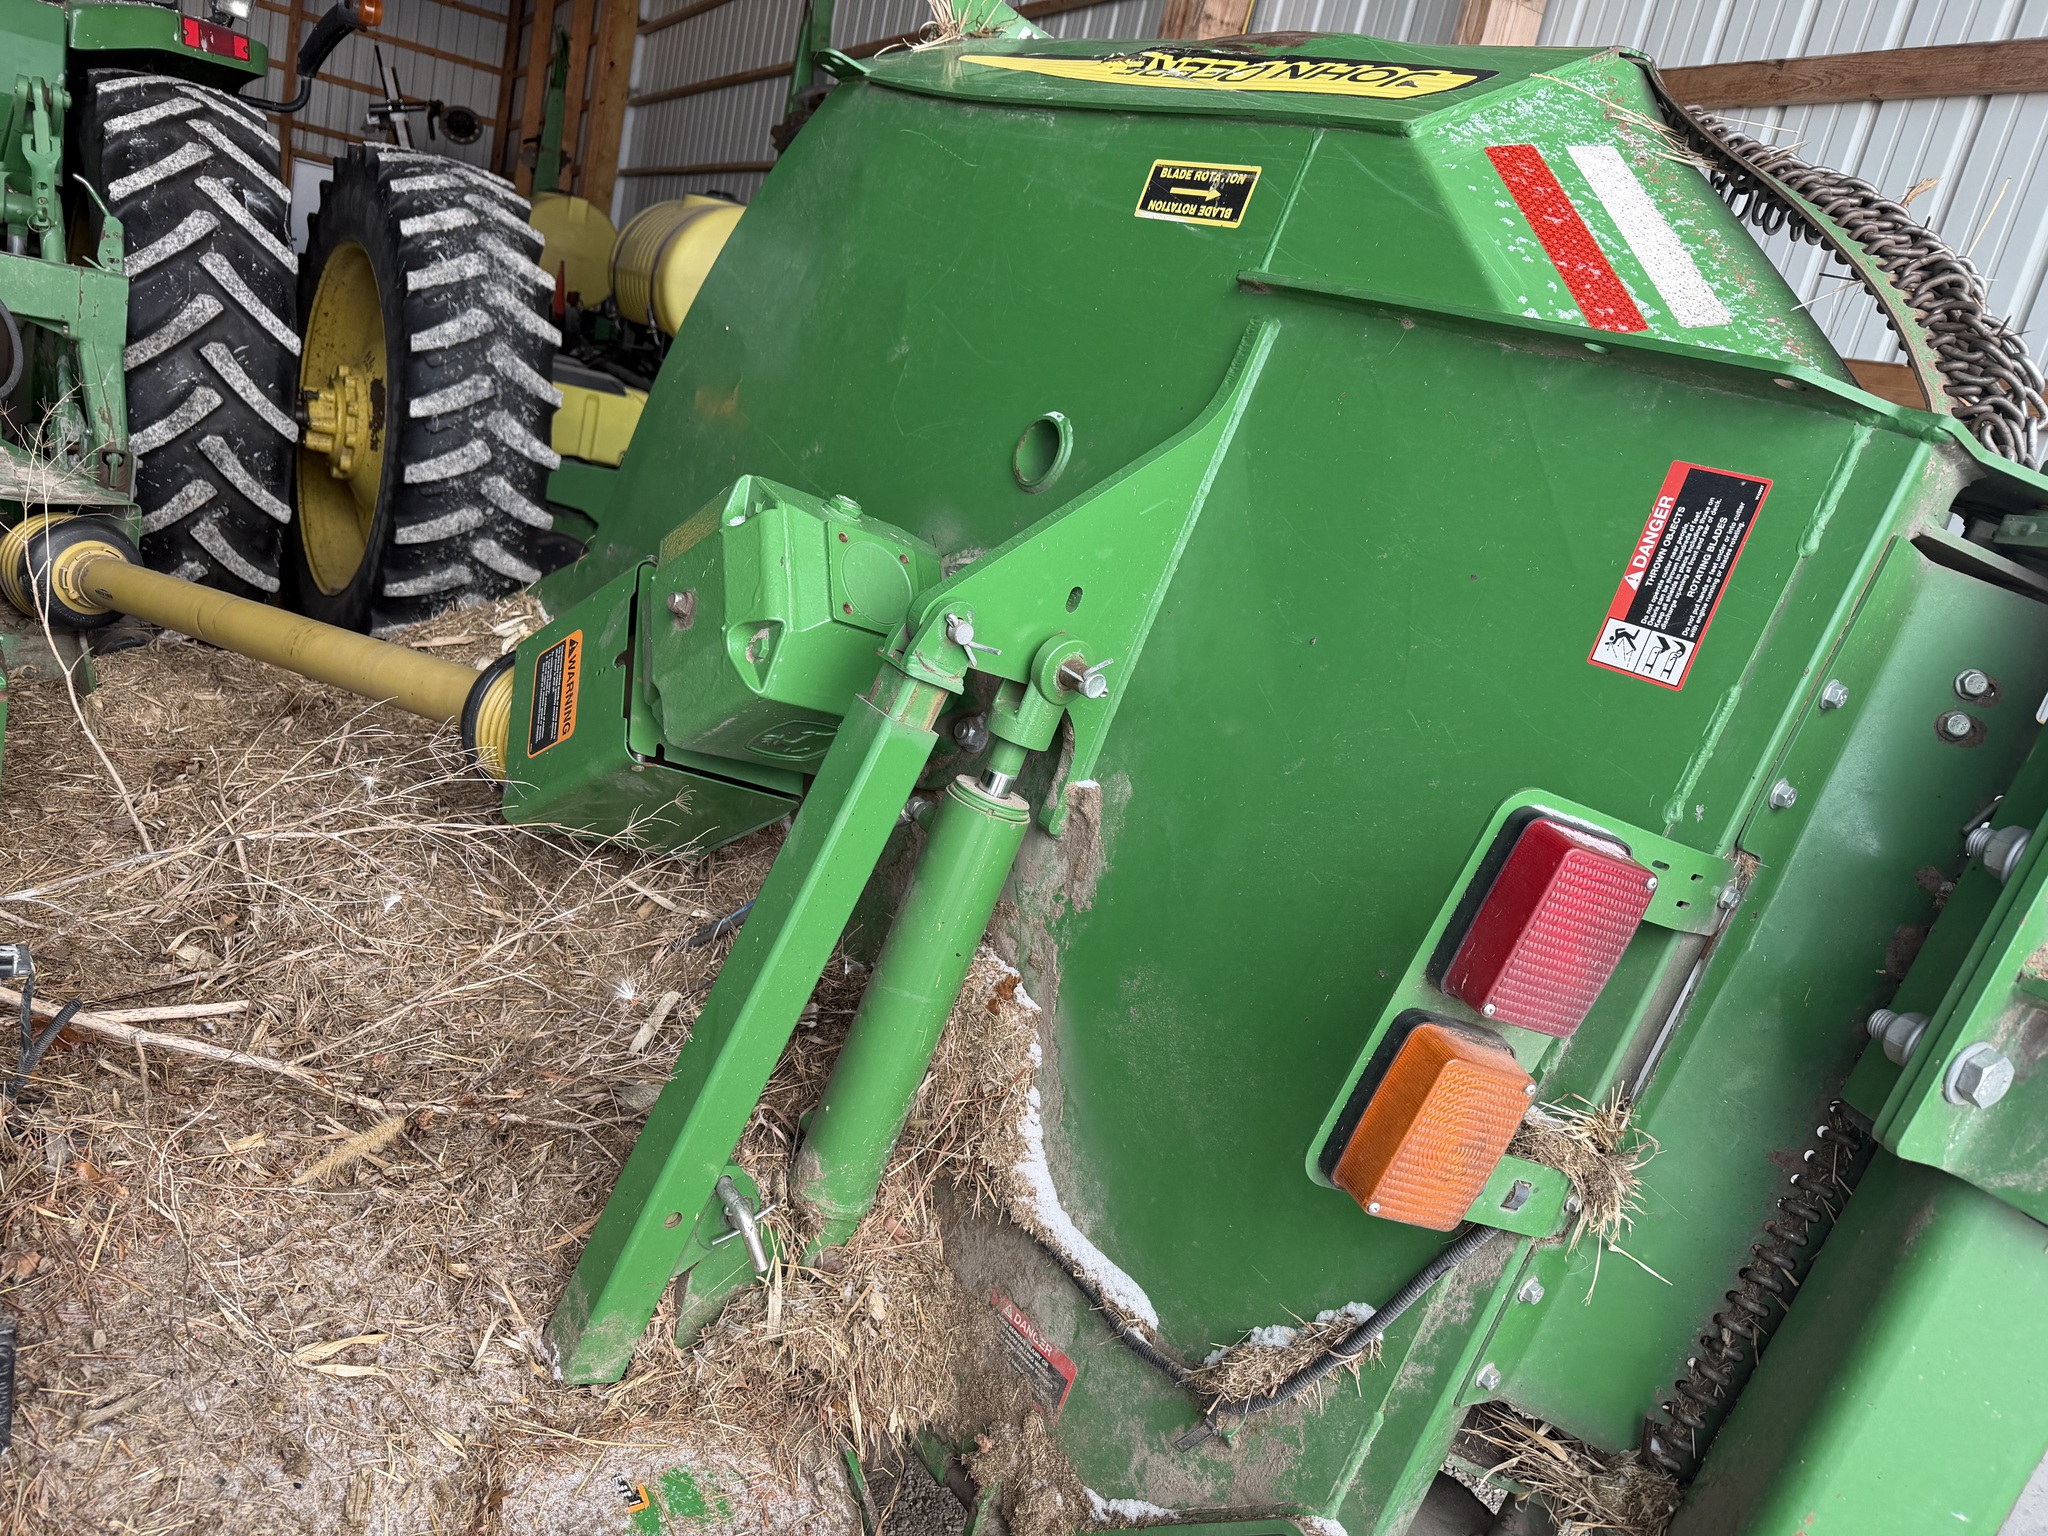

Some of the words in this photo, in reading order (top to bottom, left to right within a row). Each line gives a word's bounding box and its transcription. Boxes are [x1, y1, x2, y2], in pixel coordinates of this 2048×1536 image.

[1109, 52, 1268, 82] DEERE
[1266, 61, 1445, 88] JOHN
[1160, 167, 1193, 180] BLADE
[1194, 170, 1247, 184] ROTAION
[1147, 200, 1197, 215] ROTATION
[1198, 205, 1233, 219] BLADE
[1632, 495, 1674, 568] DANGER
[1644, 546, 1667, 586] THROWN
[1662, 506, 1685, 546] OBJECTS
[1686, 553, 1711, 597] ROTATING
[1706, 516, 1727, 552] BLADES
[562, 658, 577, 736] WARNING
[1014, 1314, 1052, 1357] DANGER
